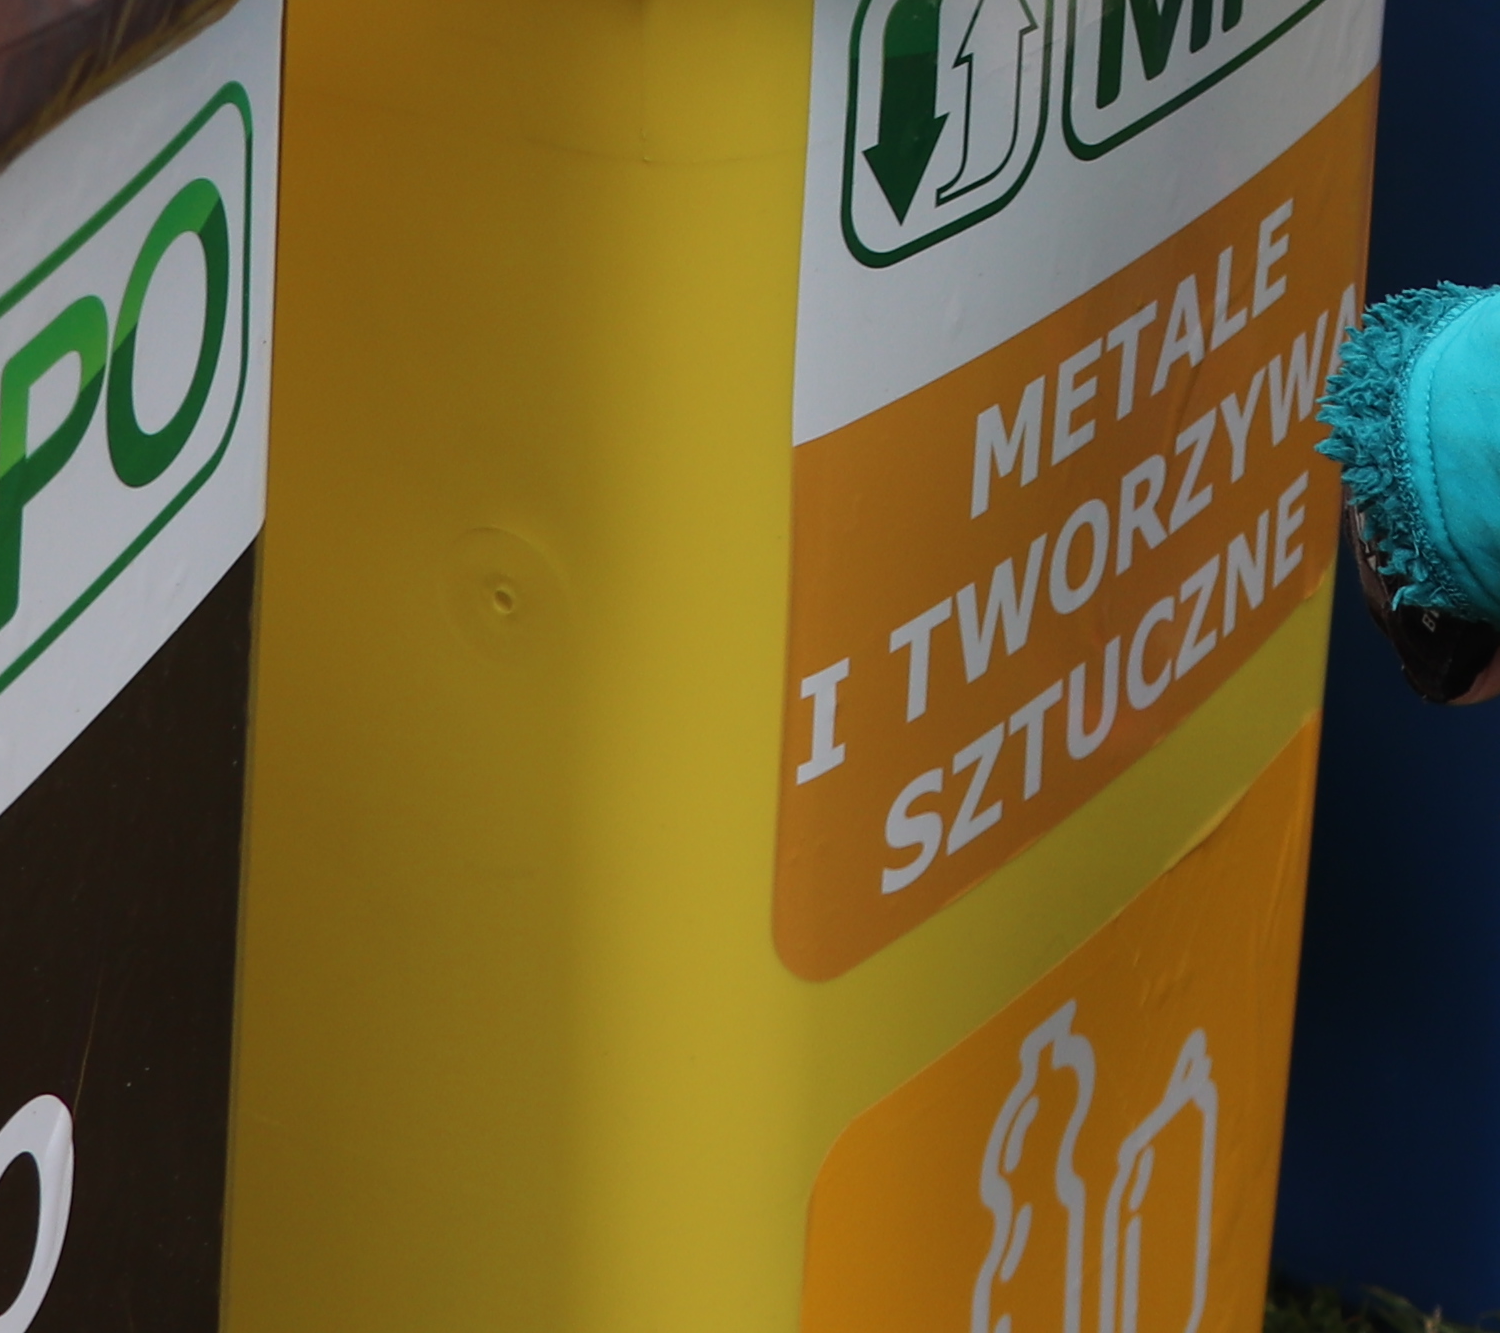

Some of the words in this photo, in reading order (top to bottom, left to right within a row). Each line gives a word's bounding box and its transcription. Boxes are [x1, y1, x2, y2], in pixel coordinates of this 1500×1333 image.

[970, 198, 1293, 519] METALE
[796, 657, 850, 785] I
[881, 472, 1308, 894] SZTUCZNE
